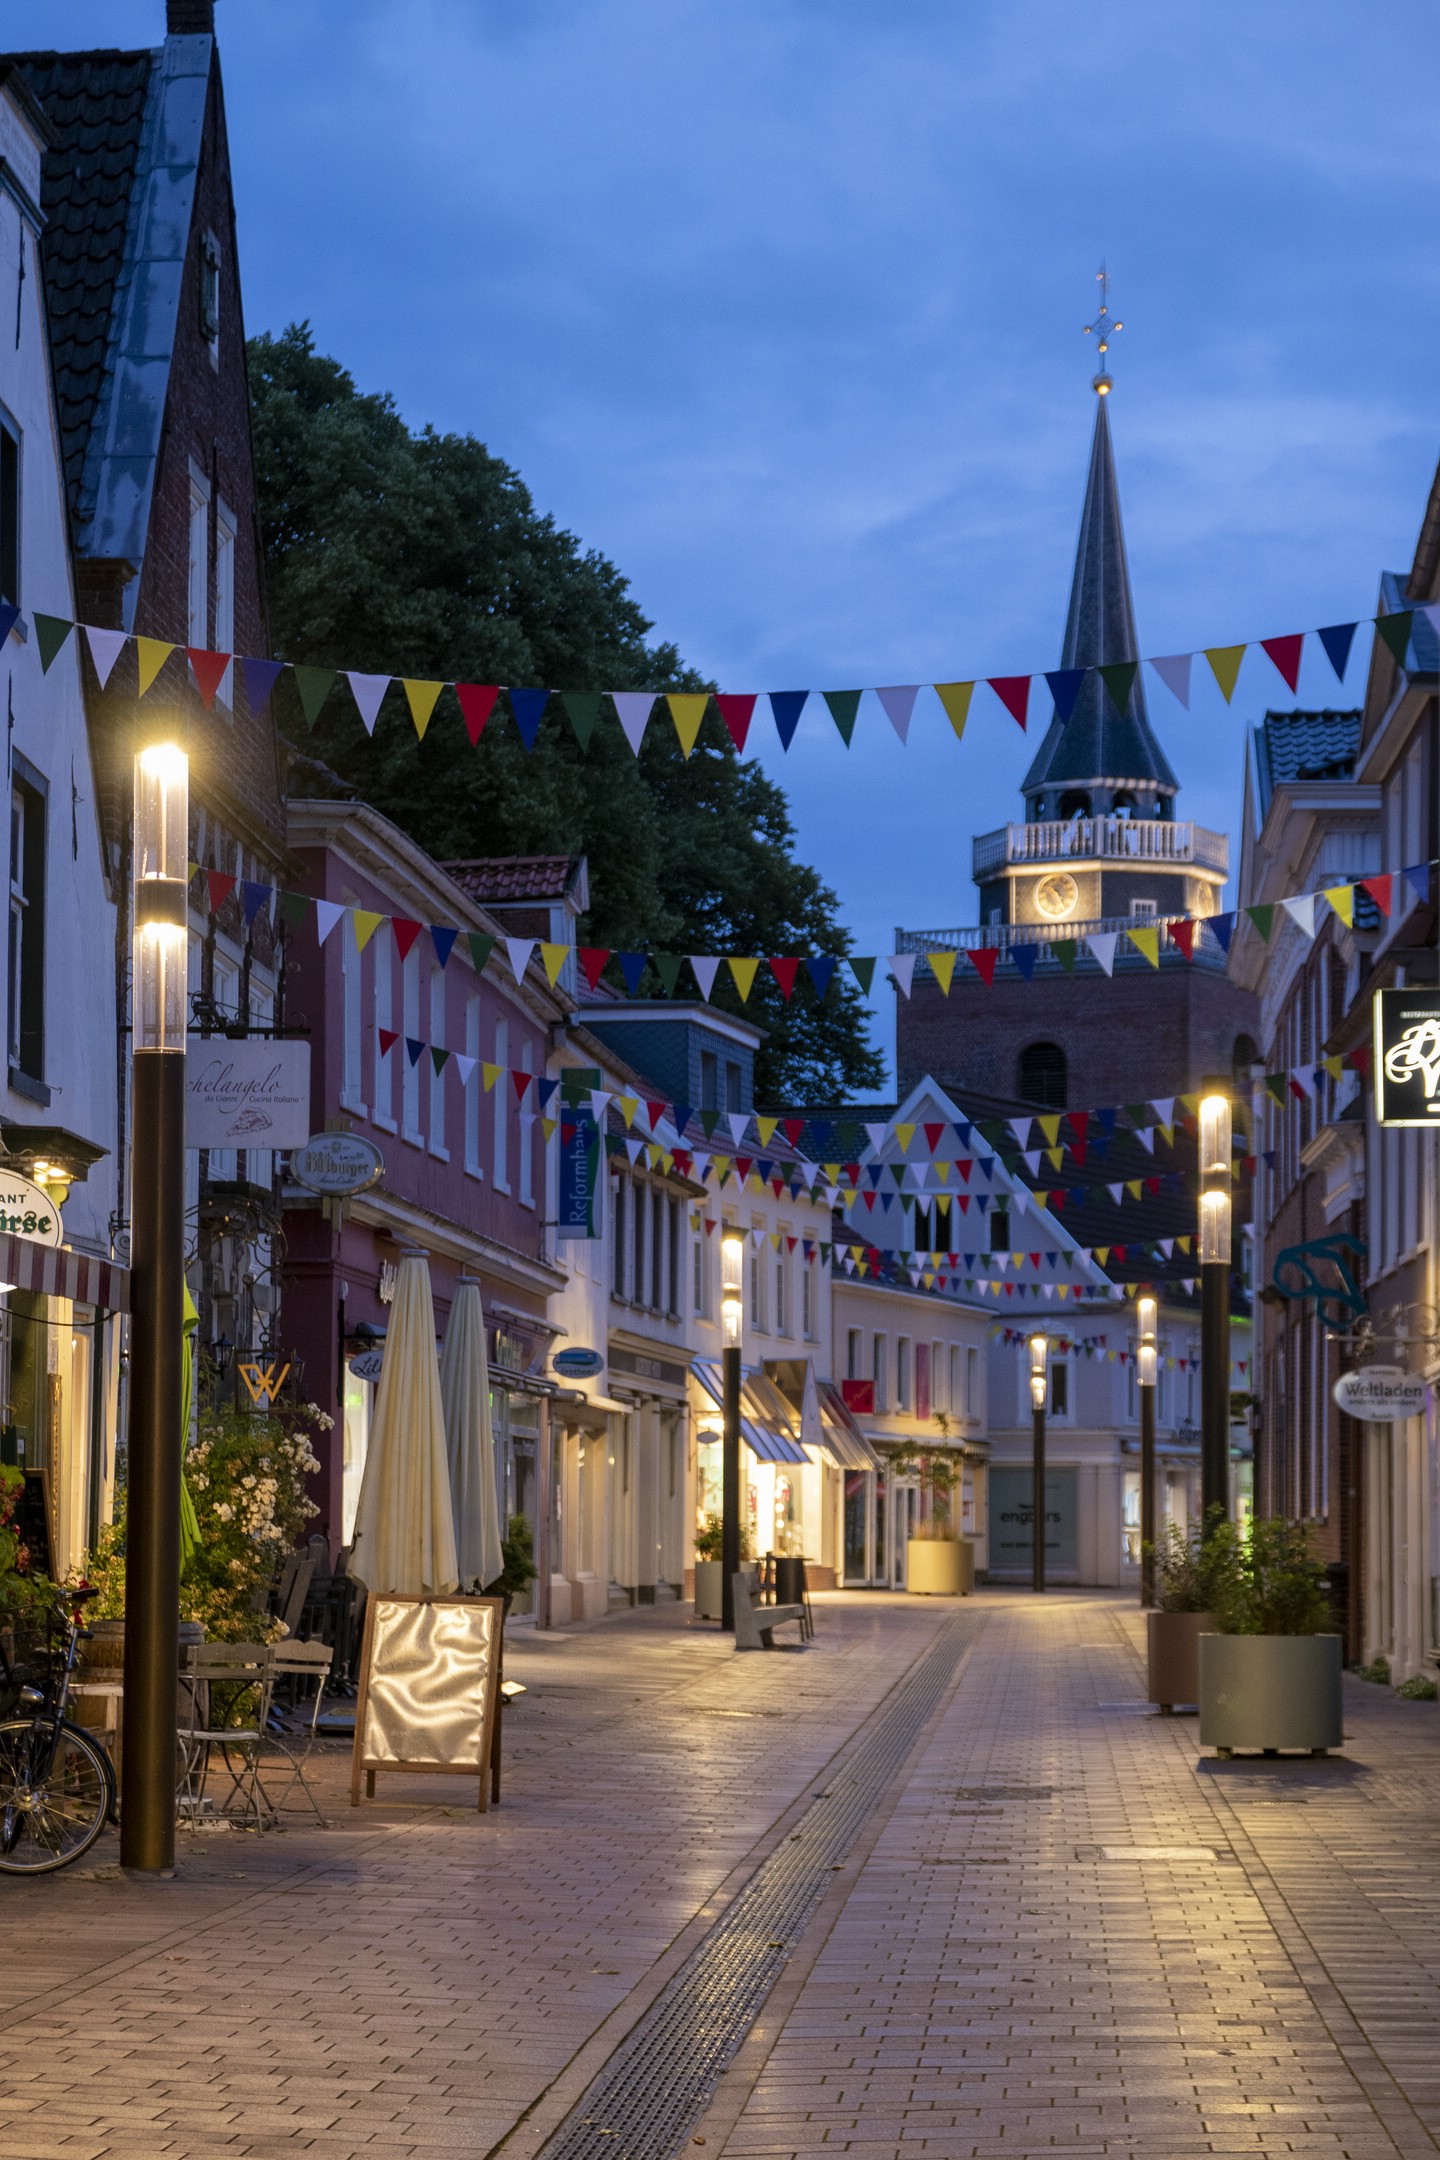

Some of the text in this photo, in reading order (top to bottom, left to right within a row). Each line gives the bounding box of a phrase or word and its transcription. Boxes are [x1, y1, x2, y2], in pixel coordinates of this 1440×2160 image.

[304, 1151, 369, 1177] Bitburger
[1345, 1382, 1423, 1397] Weltladen
[1001, 1510, 1061, 1525] engbrs
